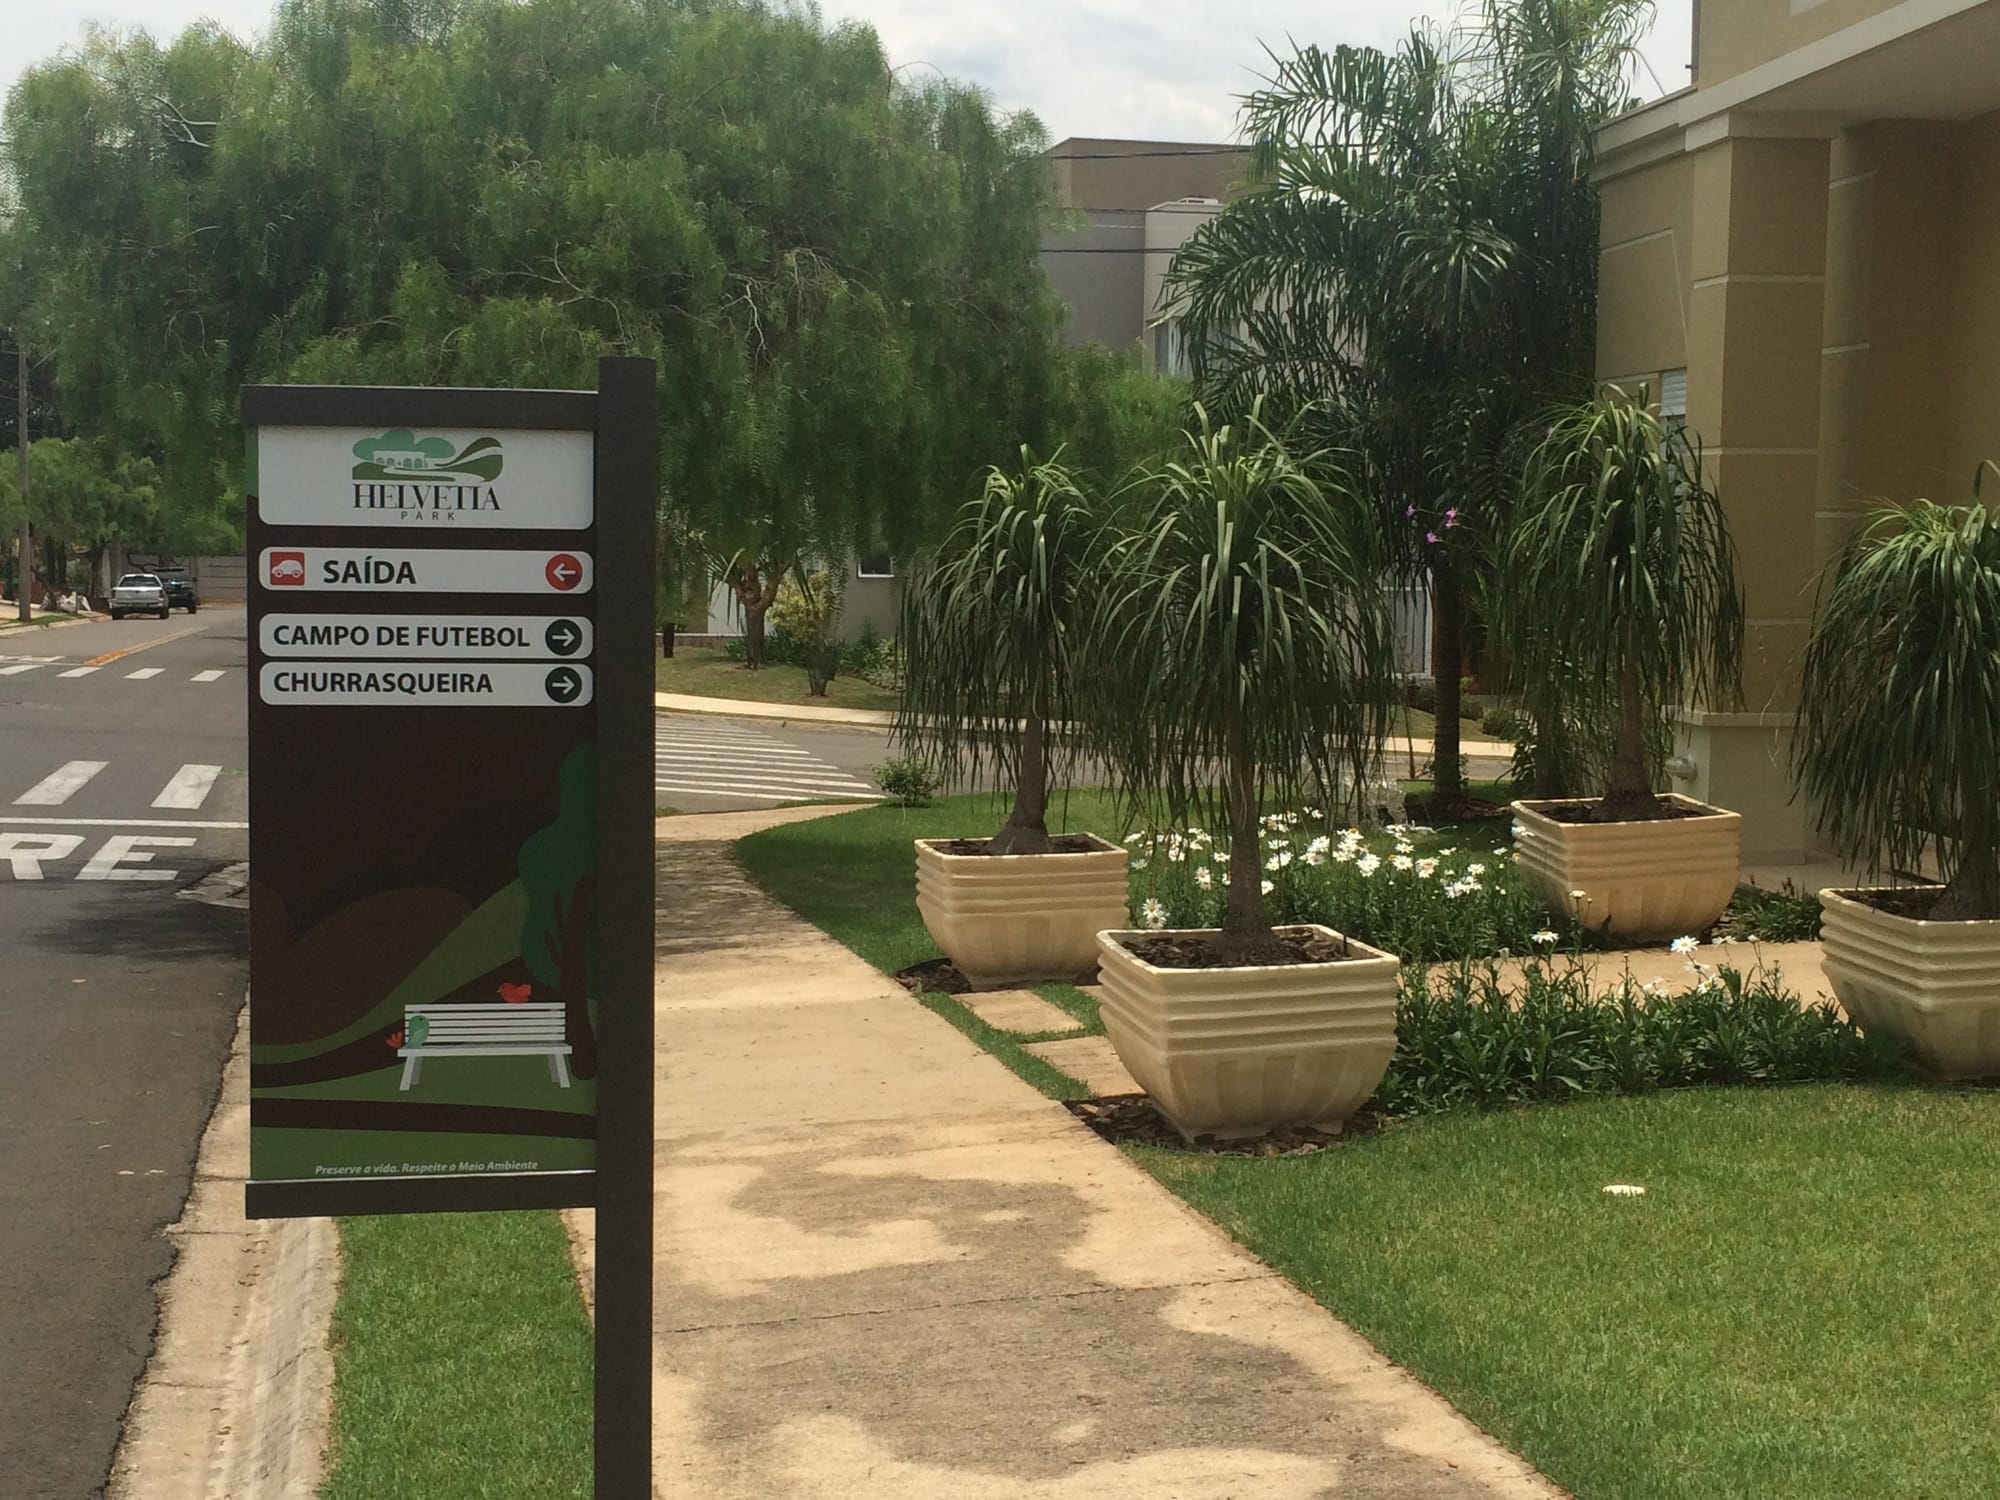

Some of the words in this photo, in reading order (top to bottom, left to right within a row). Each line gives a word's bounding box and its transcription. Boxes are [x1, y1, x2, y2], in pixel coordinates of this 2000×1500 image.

[352, 483, 502, 511] HELVETIA
[400, 510, 456, 521] PARK
[323, 556, 416, 584] SAÍDA
[273, 625, 369, 647] CAMPO
[376, 626, 410, 647] DE
[416, 626, 530, 648] FUTEBOL
[273, 672, 493, 695] CHURRASQUEIRA
[315, 1164, 362, 1175] Preserve
[363, 1165, 371, 1174] a
[373, 1162, 399, 1173] vida.
[402, 1162, 447, 1174] Respeite
[458, 1161, 486, 1171] Meio
[487, 1160, 539, 1171] Ambiente
